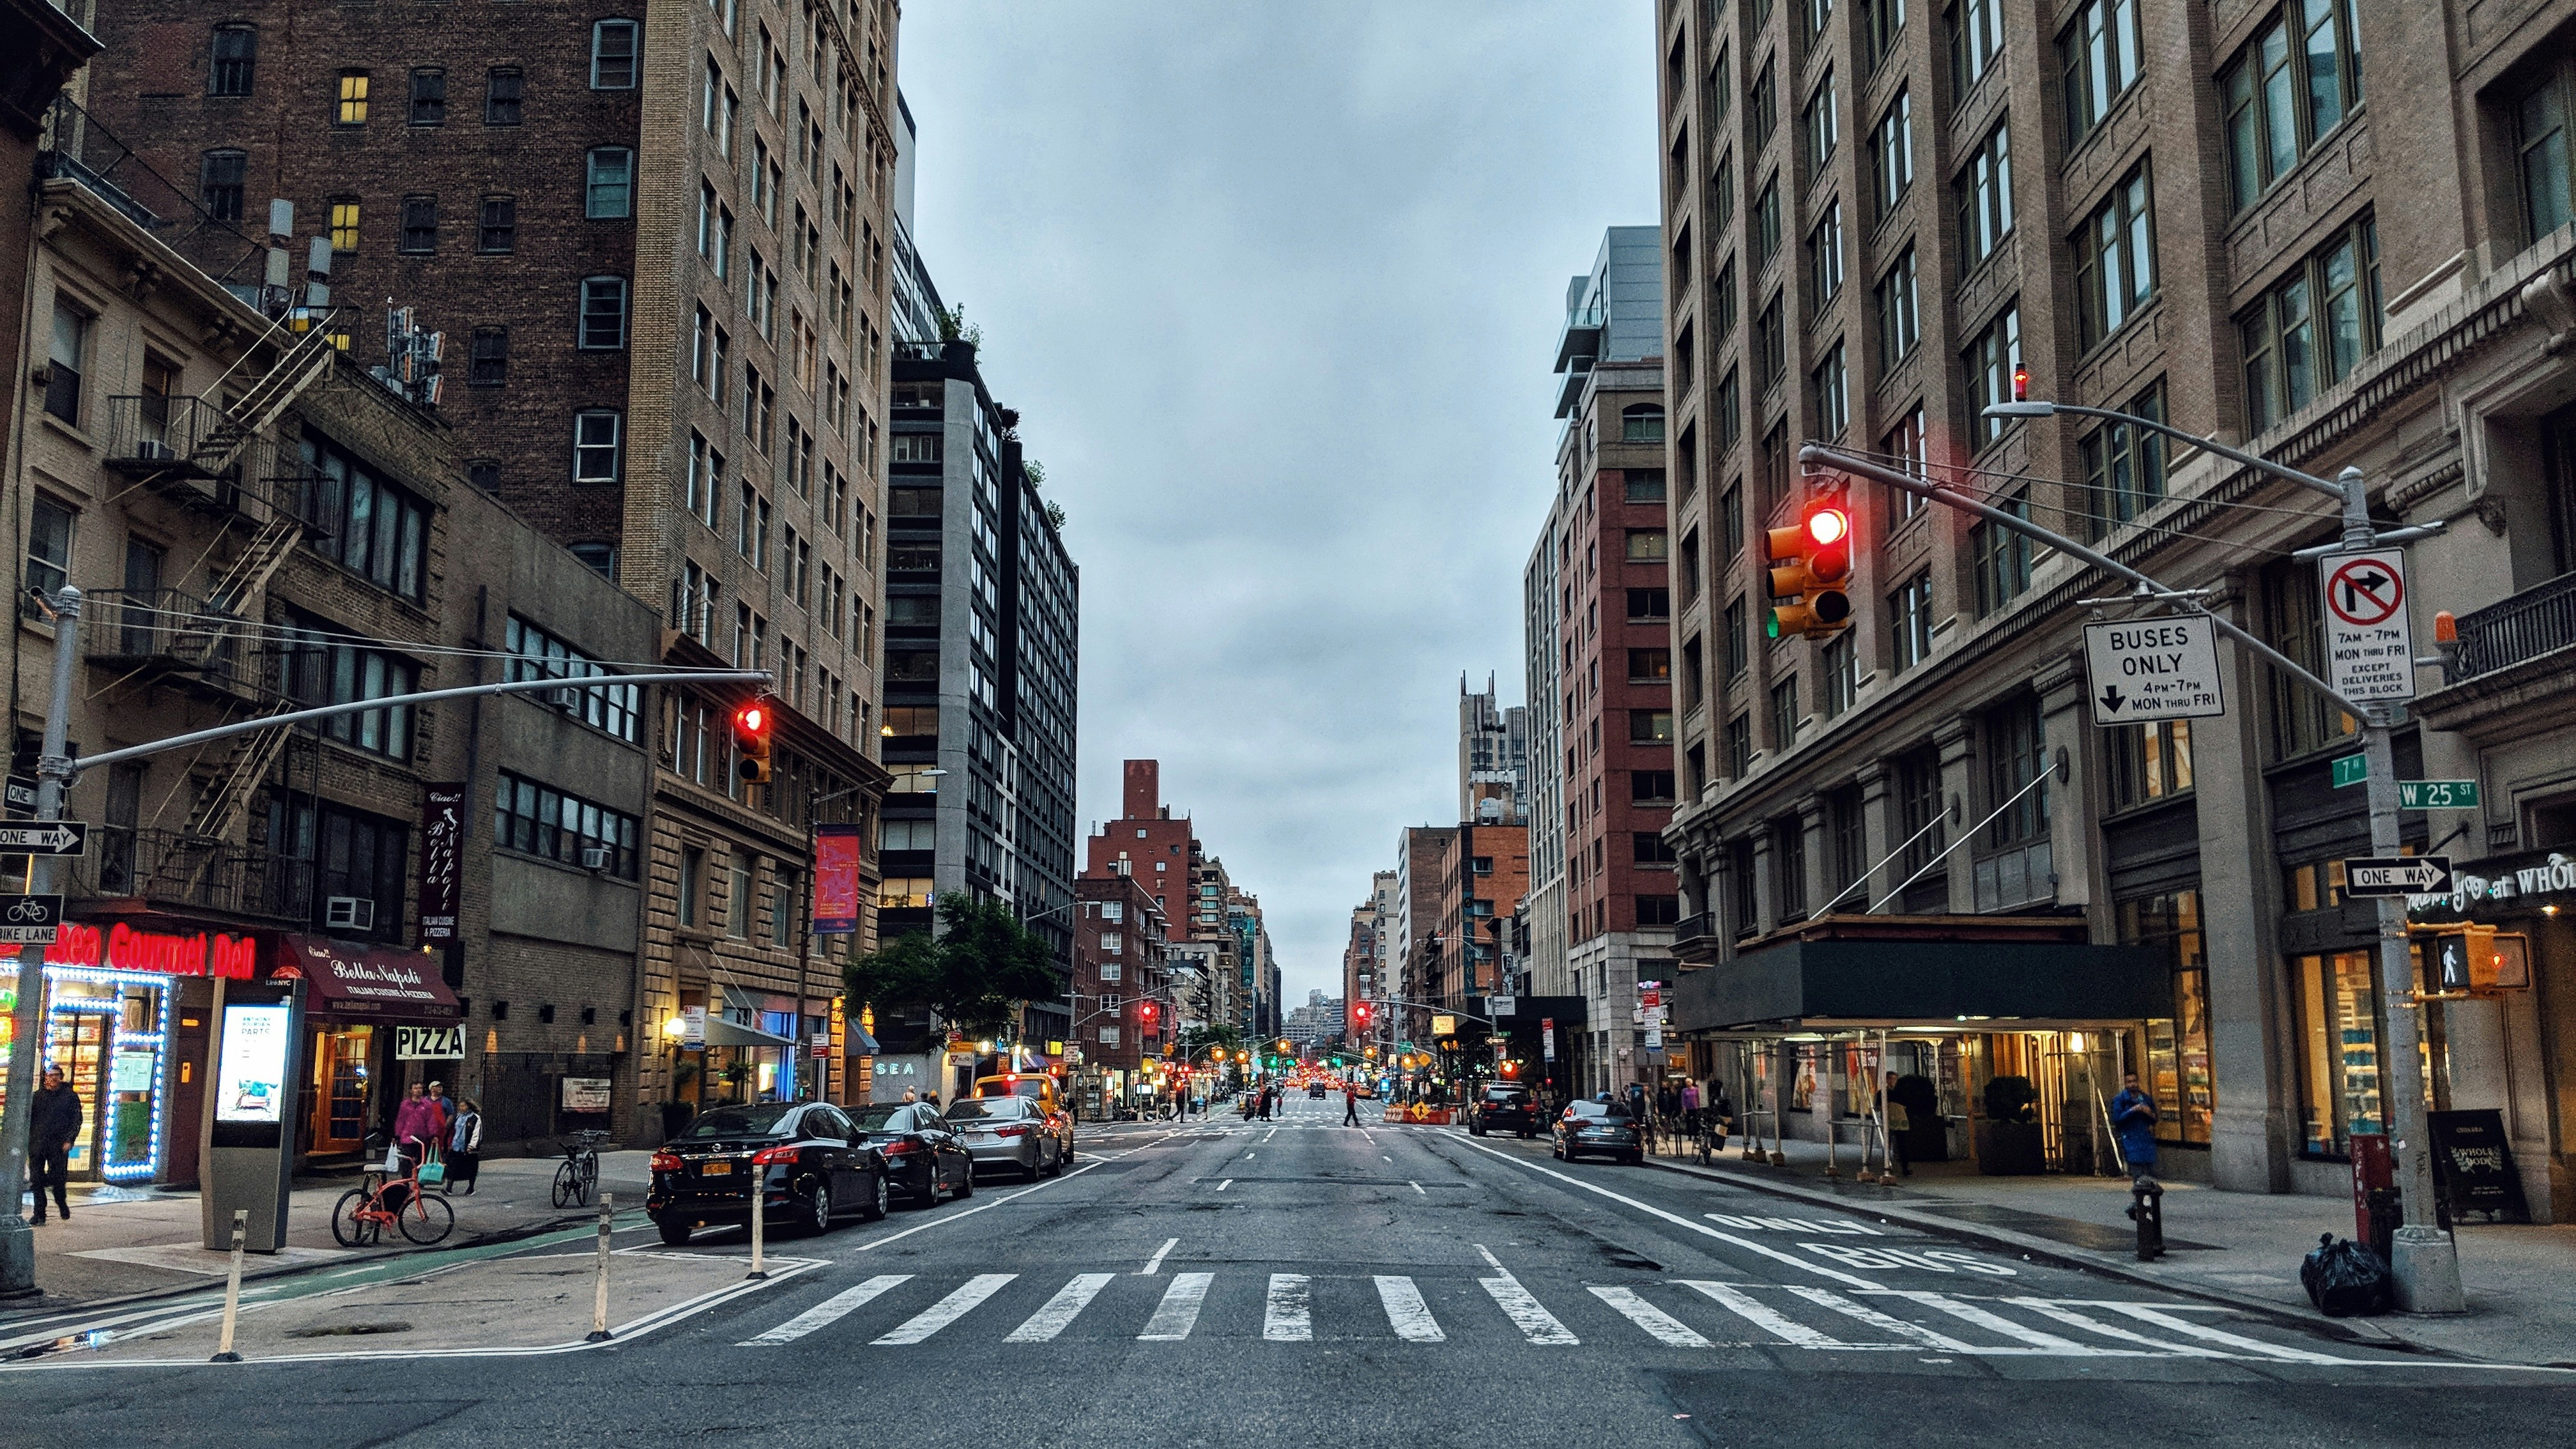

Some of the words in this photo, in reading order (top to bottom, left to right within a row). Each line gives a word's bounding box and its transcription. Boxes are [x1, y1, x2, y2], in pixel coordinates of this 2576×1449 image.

[2110, 627, 2188, 650] BUSES
[2338, 632, 2361, 643] 7AM
[2375, 629, 2400, 640] 7PM
[2335, 648, 2359, 660] MON
[2387, 645, 2405, 656] FRI
[2122, 653, 2182, 675] ONLY
[2352, 663, 2390, 673] EXCEPT
[2342, 672, 2402, 685] DELIVERIES
[2343, 687, 2365, 695] THIS
[2370, 684, 2402, 694] BLOCK
[2132, 697, 2161, 710] MON
[2165, 698, 2189, 707] THRU
[2194, 693, 2216, 706] FRI
[2342, 761, 2349, 781] 7
[10, 786, 29, 802] ONE
[429, 792, 461, 802] Ciao!!
[2402, 785, 2417, 805] W
[2426, 785, 2452, 805] 25
[2460, 784, 2471, 795] ST
[0, 831, 27, 843] ONE
[41, 832, 70, 847] WAY
[427, 821, 445, 884] Bella
[440, 832, 459, 910] Napoli
[2361, 870, 2392, 884] ONE
[2404, 869, 2435, 883] WAY
[26, 928, 55, 940] LANE
[429, 928, 450, 937] PIZZERIA
[110, 922, 208, 977] Gourmet
[330, 960, 377, 979] Bella
[377, 965, 422, 990] Napoli
[346, 986, 374, 995] ITALIAN
[374, 988, 400, 997] CUISINE
[400, 990, 406, 998] &
[406, 990, 435, 999] PIZZERIA
[397, 1028, 464, 1055] PIZZA
[876, 1063, 914, 1075] SEA
[1703, 1213, 1885, 1236] ONLY
[1795, 1243, 2017, 1276] BUS
